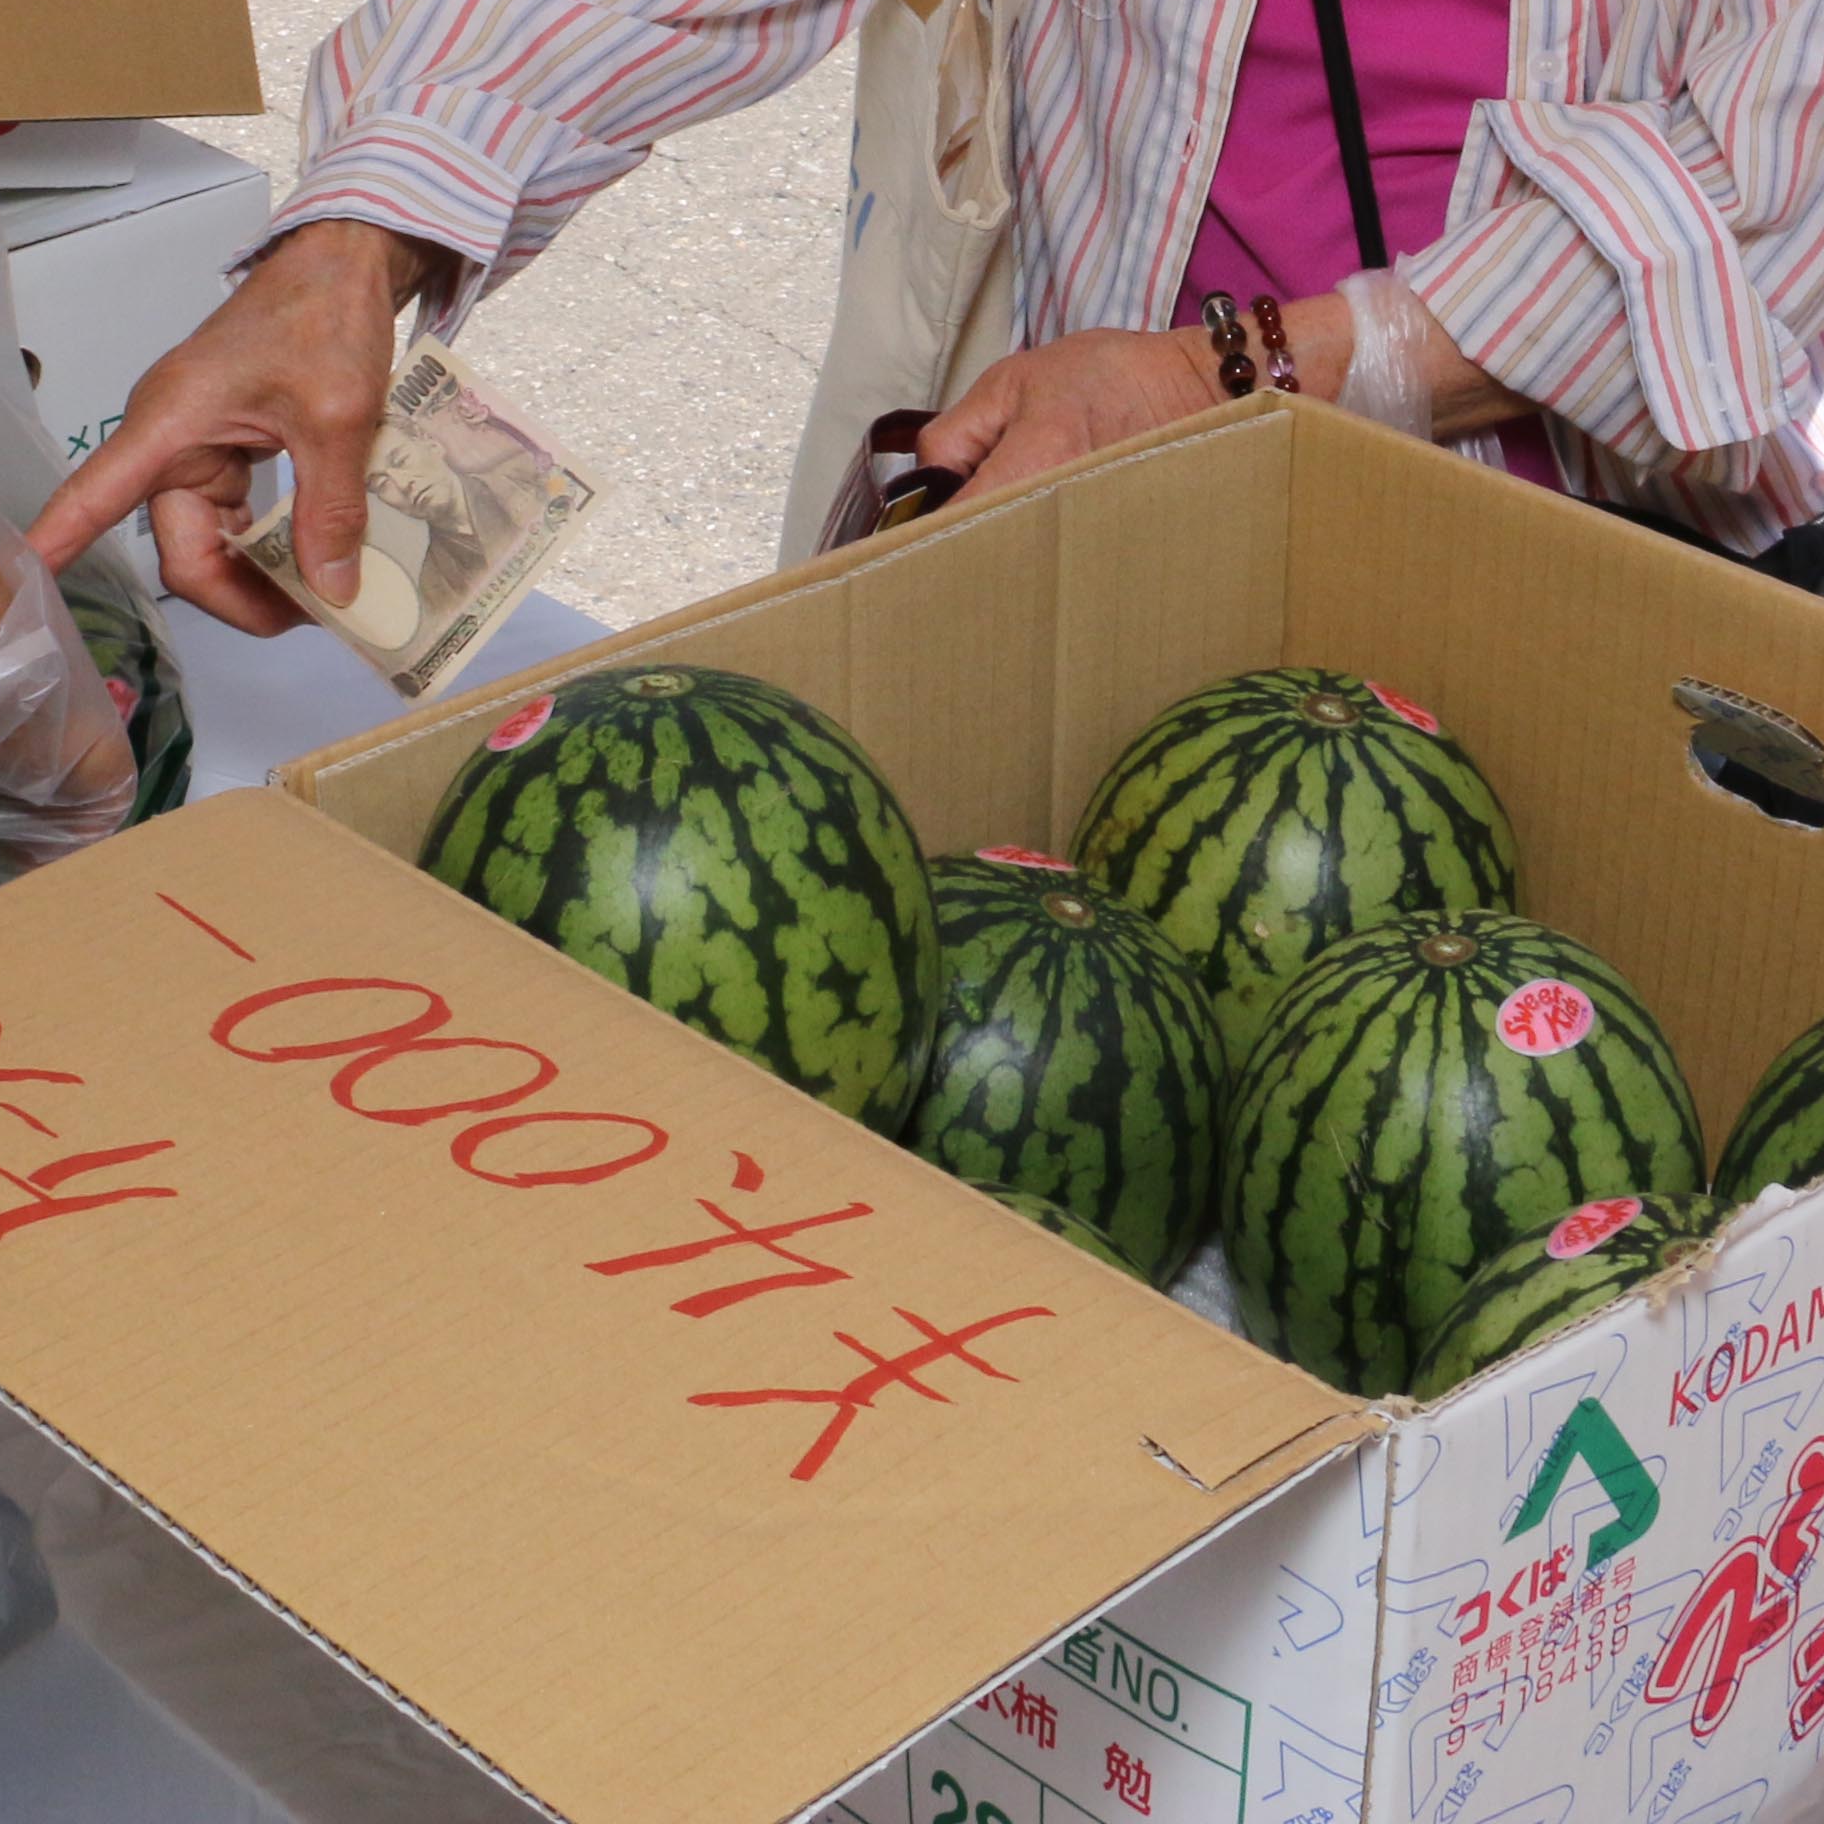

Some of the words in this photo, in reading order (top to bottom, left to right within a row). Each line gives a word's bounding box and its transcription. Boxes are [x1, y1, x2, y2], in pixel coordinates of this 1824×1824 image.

[388, 353, 449, 417] 10000
[1451, 1556, 1637, 1693] 商標登録番号
[1454, 1543, 1575, 1646] つくば
[1103, 1741, 1153, 1817] 勉
